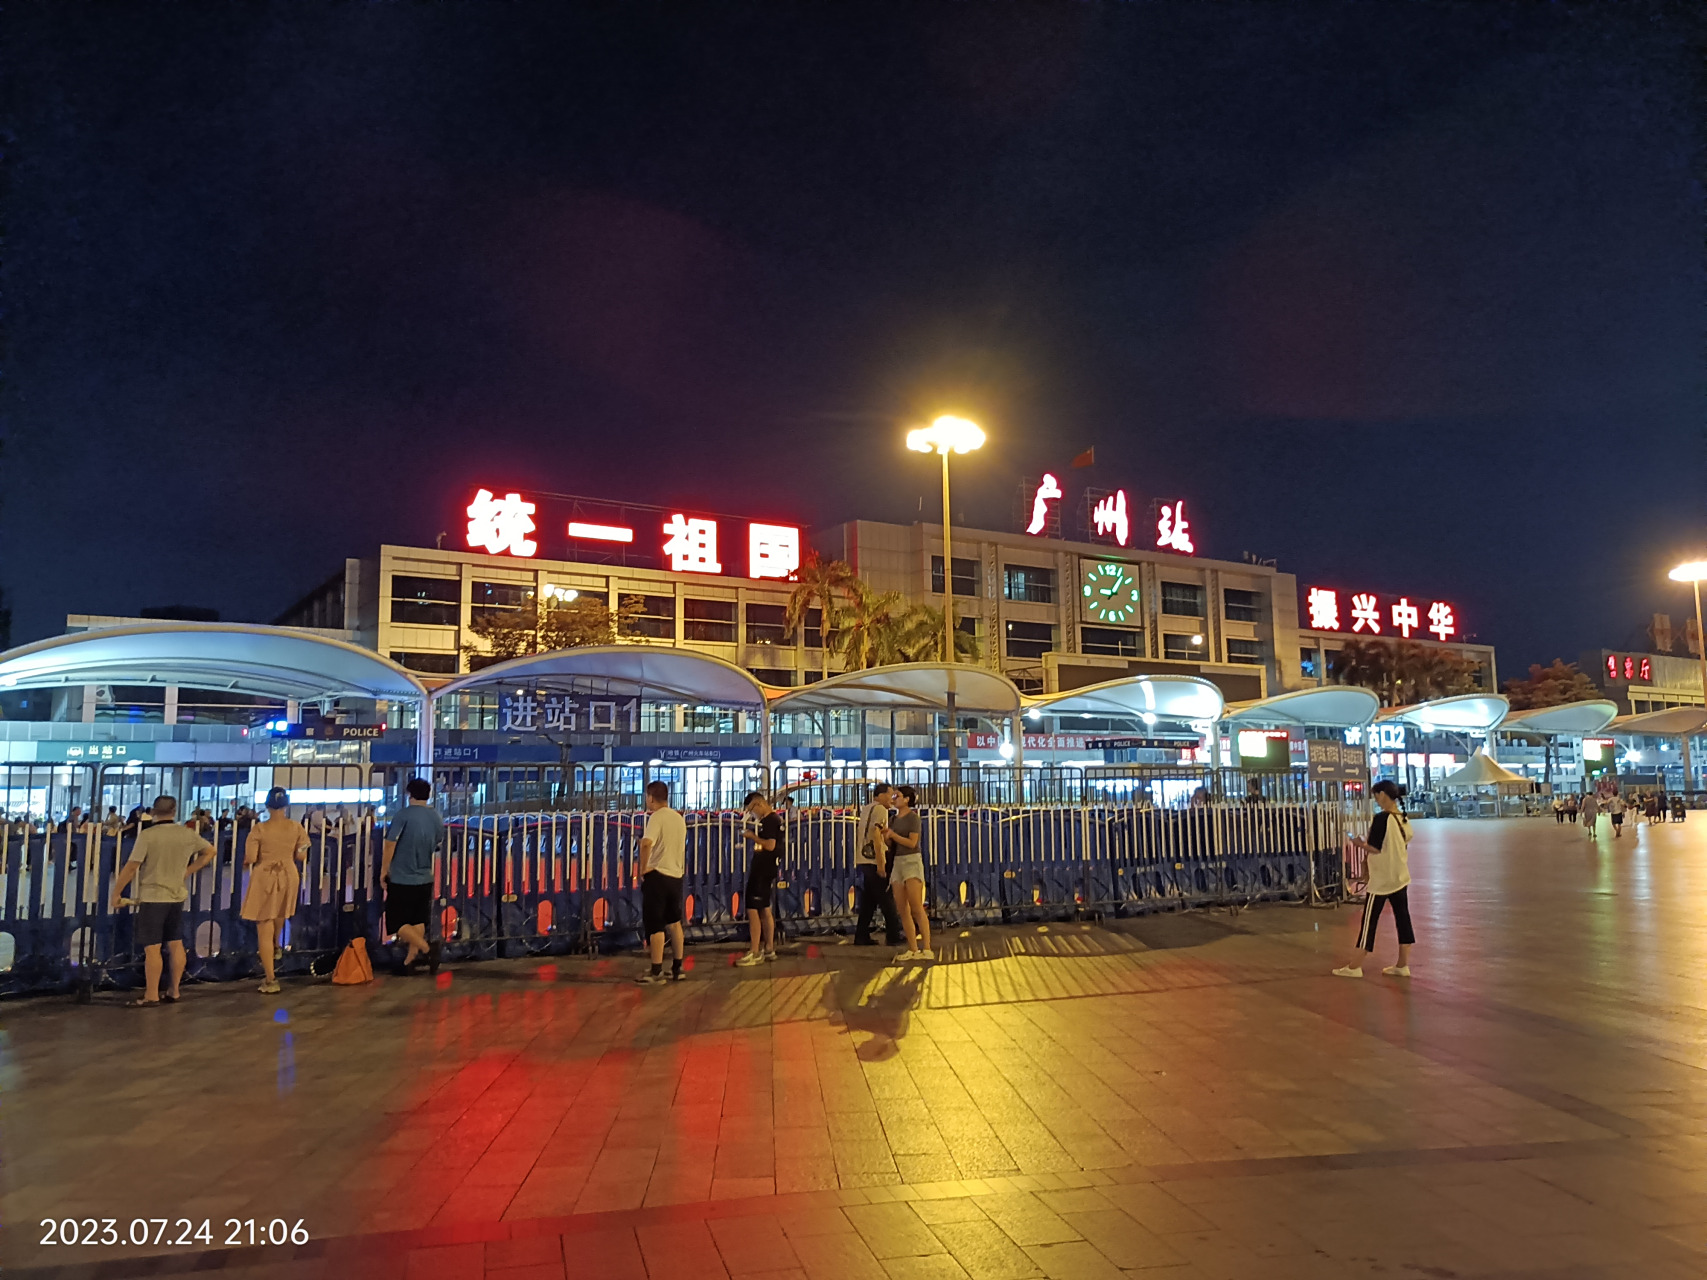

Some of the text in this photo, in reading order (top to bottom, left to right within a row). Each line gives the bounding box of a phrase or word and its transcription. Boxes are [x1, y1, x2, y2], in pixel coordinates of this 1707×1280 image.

[466, 488, 800, 581] 统一祖国
[1026, 473, 1195, 553] 广州站
[1104, 564, 1117, 576] 12
[1308, 587, 1455, 641] 振兴中华
[343, 727, 379, 737] POLICE
[502, 696, 637, 733] 进站口1
